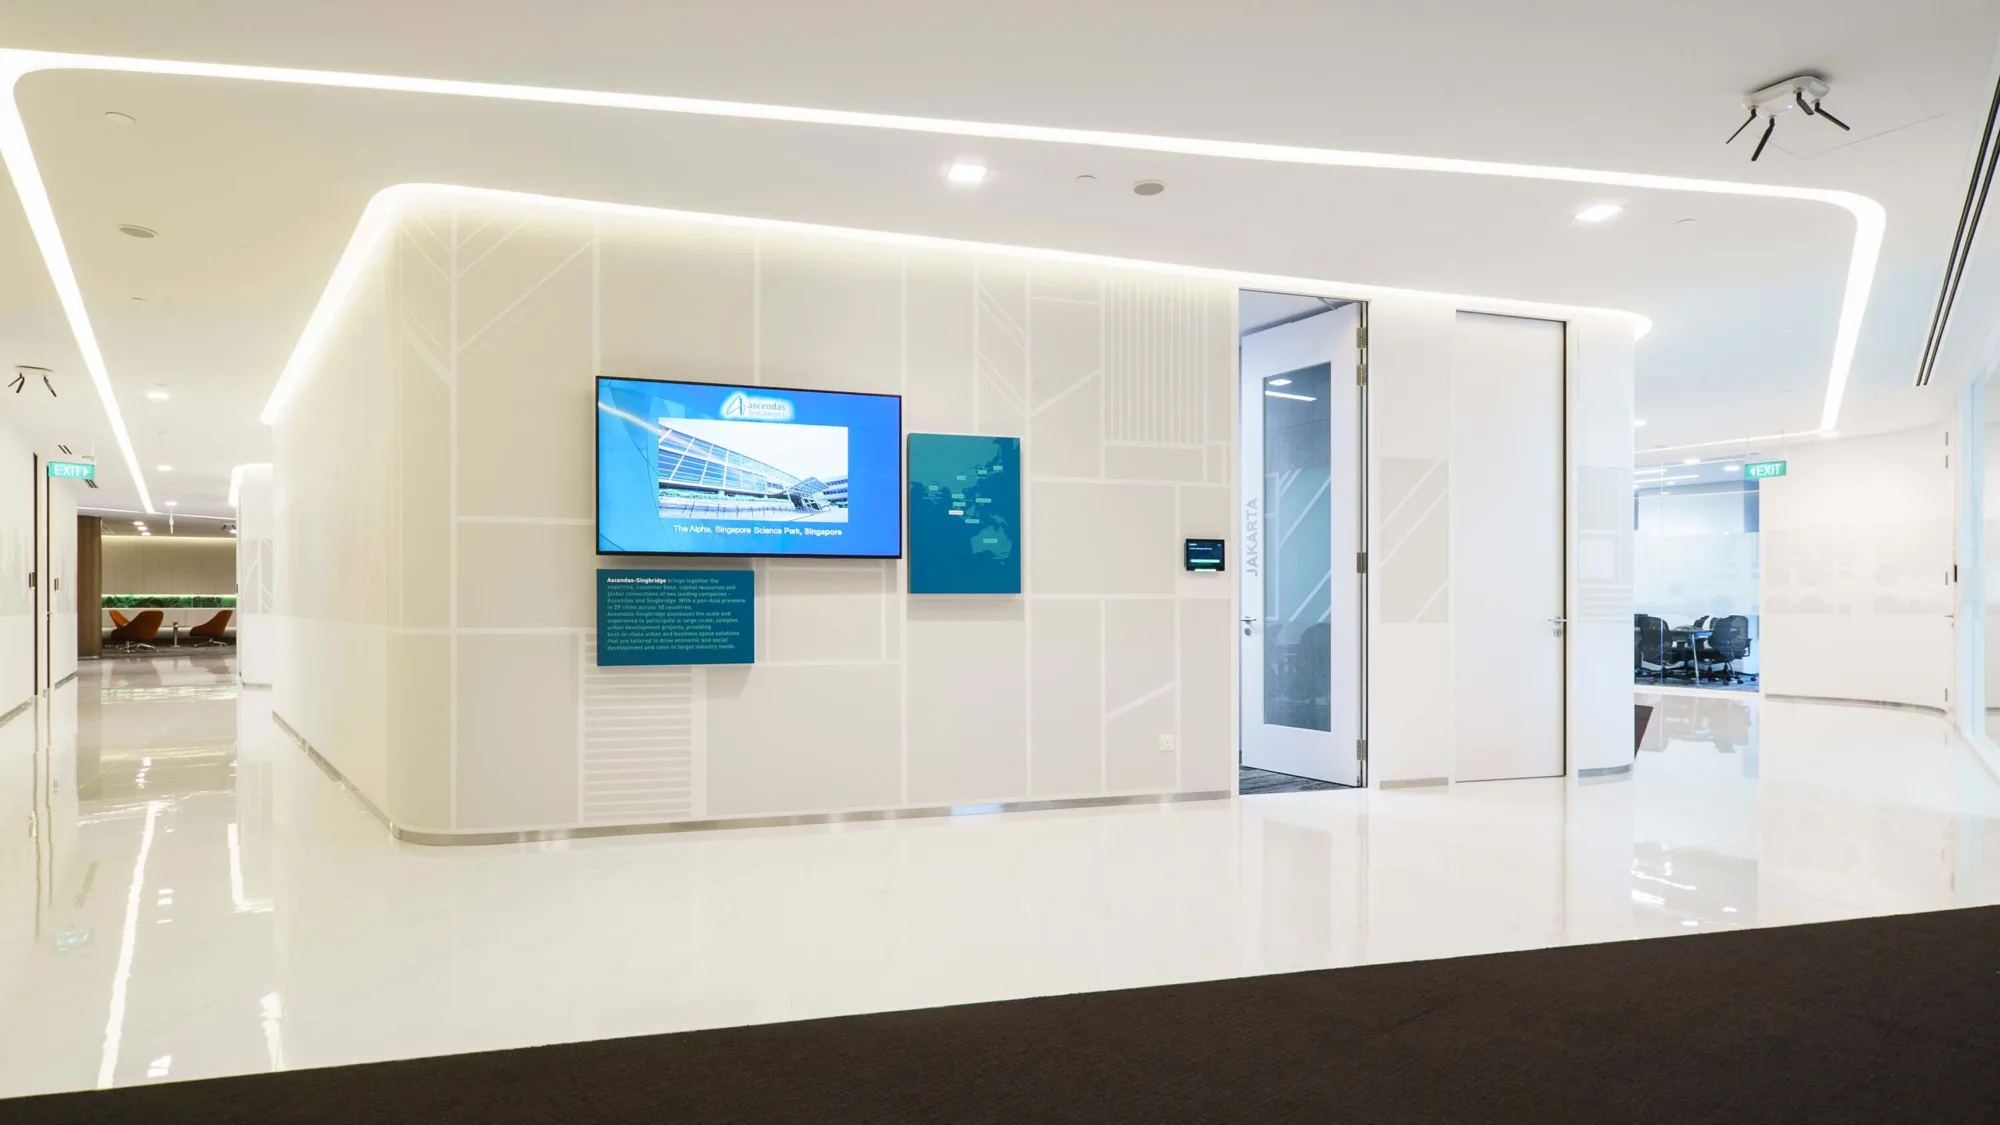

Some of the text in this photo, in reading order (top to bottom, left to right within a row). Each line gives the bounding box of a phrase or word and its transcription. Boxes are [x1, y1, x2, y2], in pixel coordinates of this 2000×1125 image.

[748, 402, 786, 410] ascendas
[54, 464, 80, 476] EXIT
[1757, 464, 1782, 476] EXIT
[690, 525, 712, 534] Alpha,
[715, 526, 751, 534] Singapore
[804, 528, 842, 536] Singapore
[1246, 498, 1258, 577] JAKARTA
